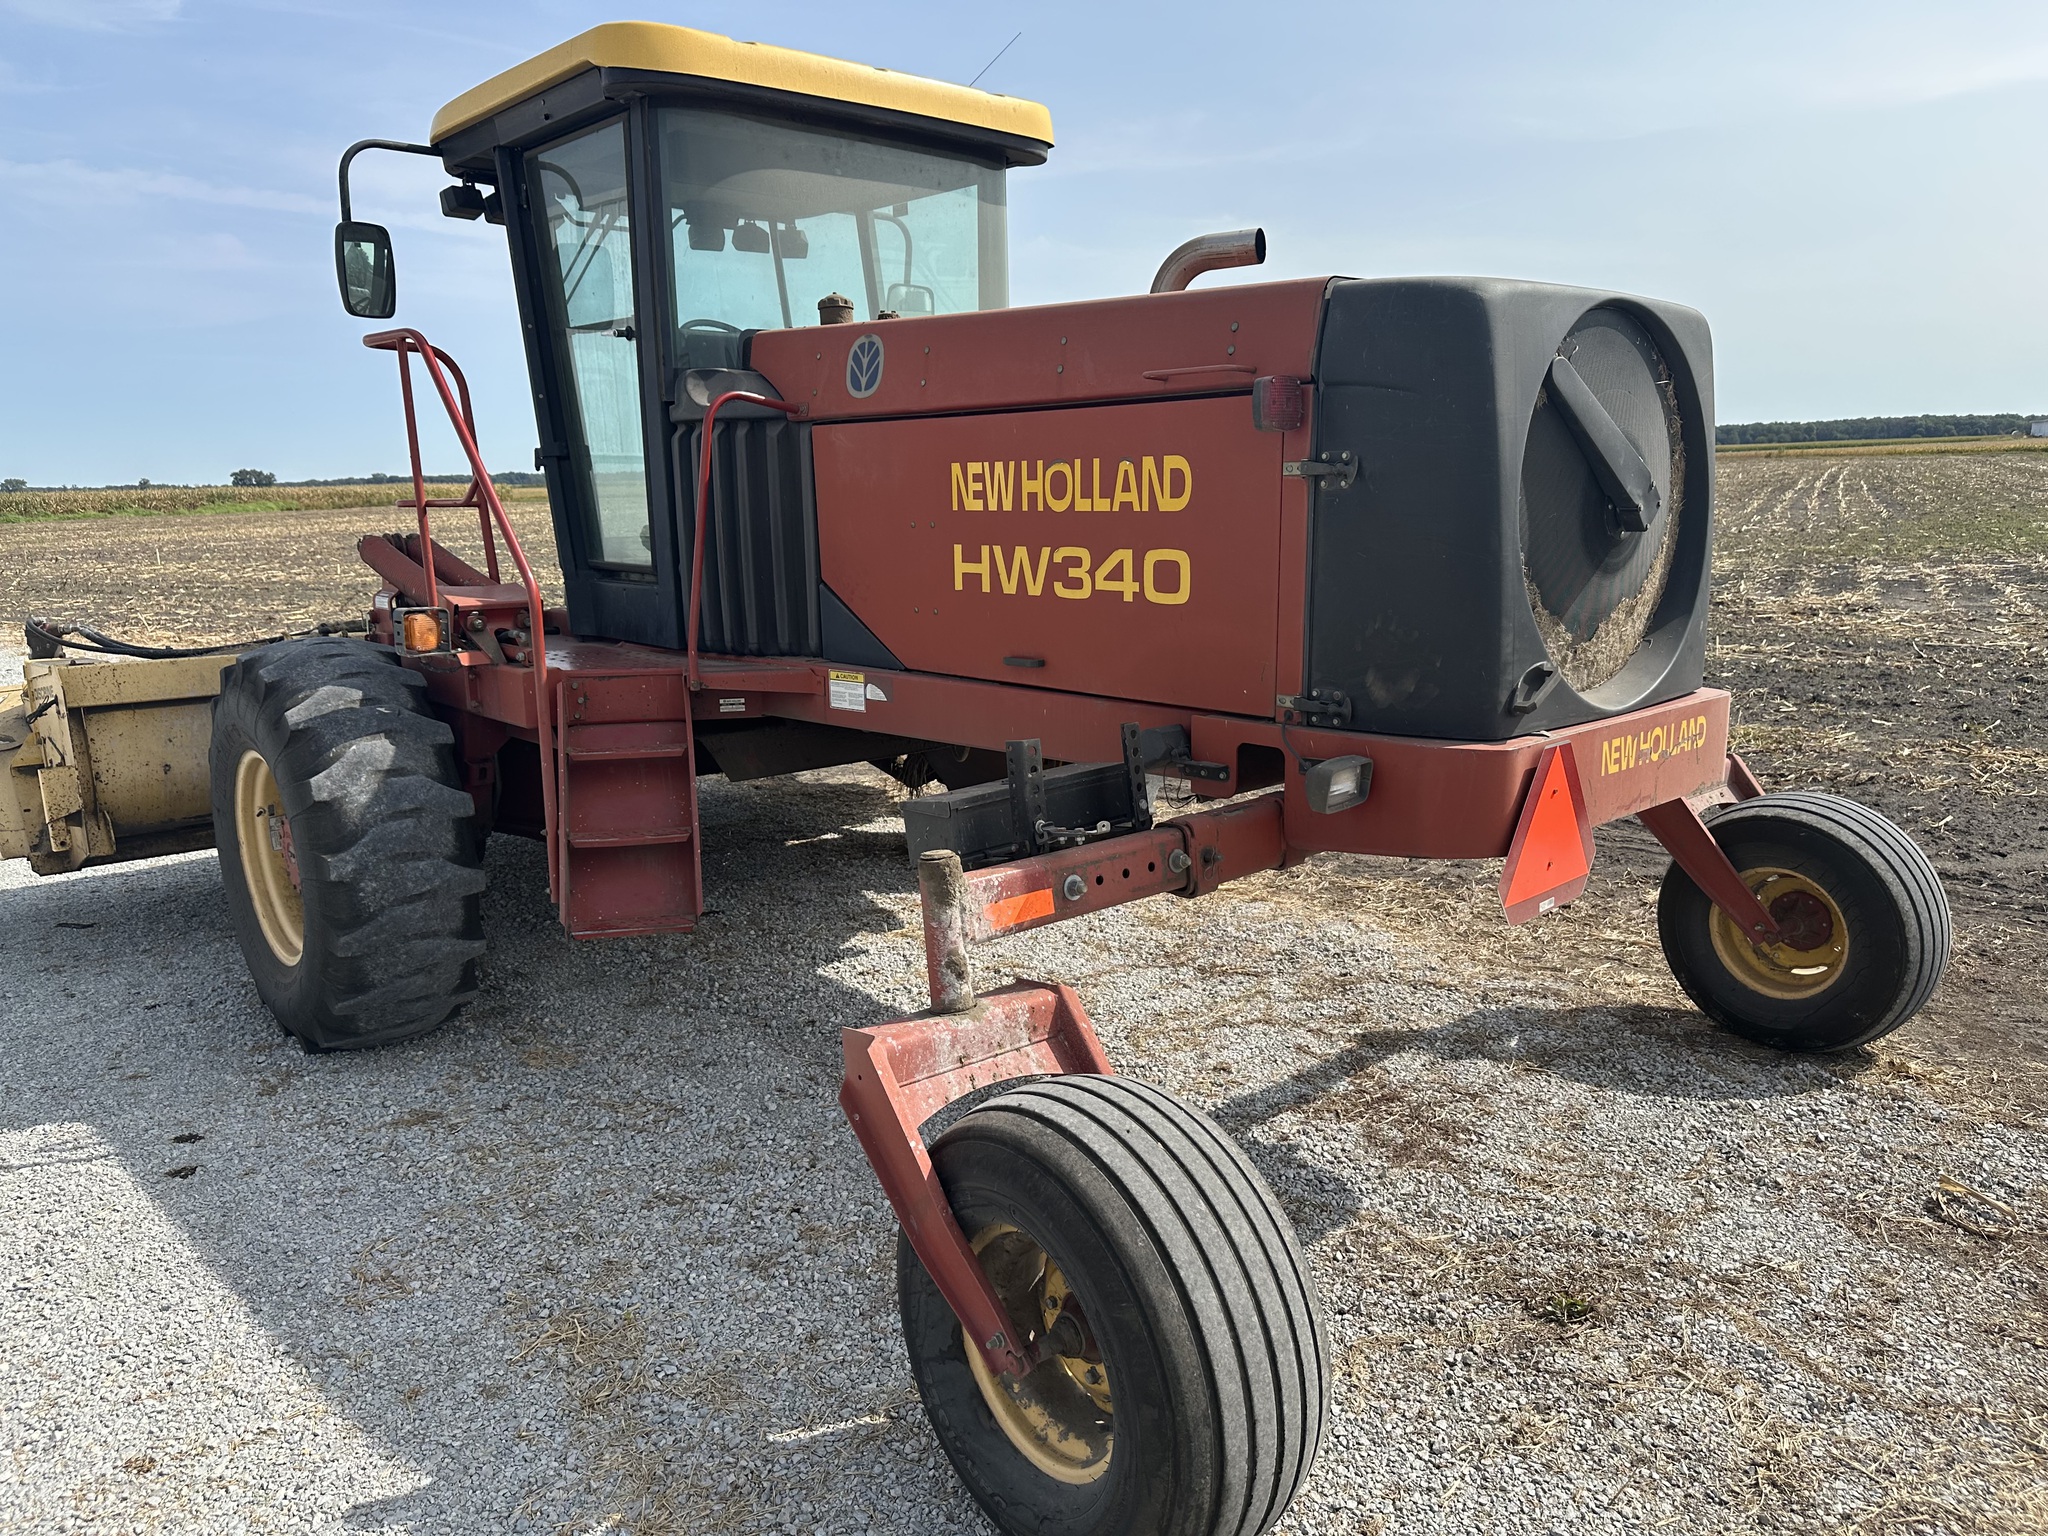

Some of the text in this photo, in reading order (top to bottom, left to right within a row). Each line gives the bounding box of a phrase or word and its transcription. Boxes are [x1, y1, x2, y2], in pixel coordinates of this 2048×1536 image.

[951, 455, 1193, 513] NEW HOLLAND
[953, 543, 1191, 605] HW340
[840, 673, 859, 681] CAUTION
[1601, 715, 1707, 777] NEW HOLLAND
